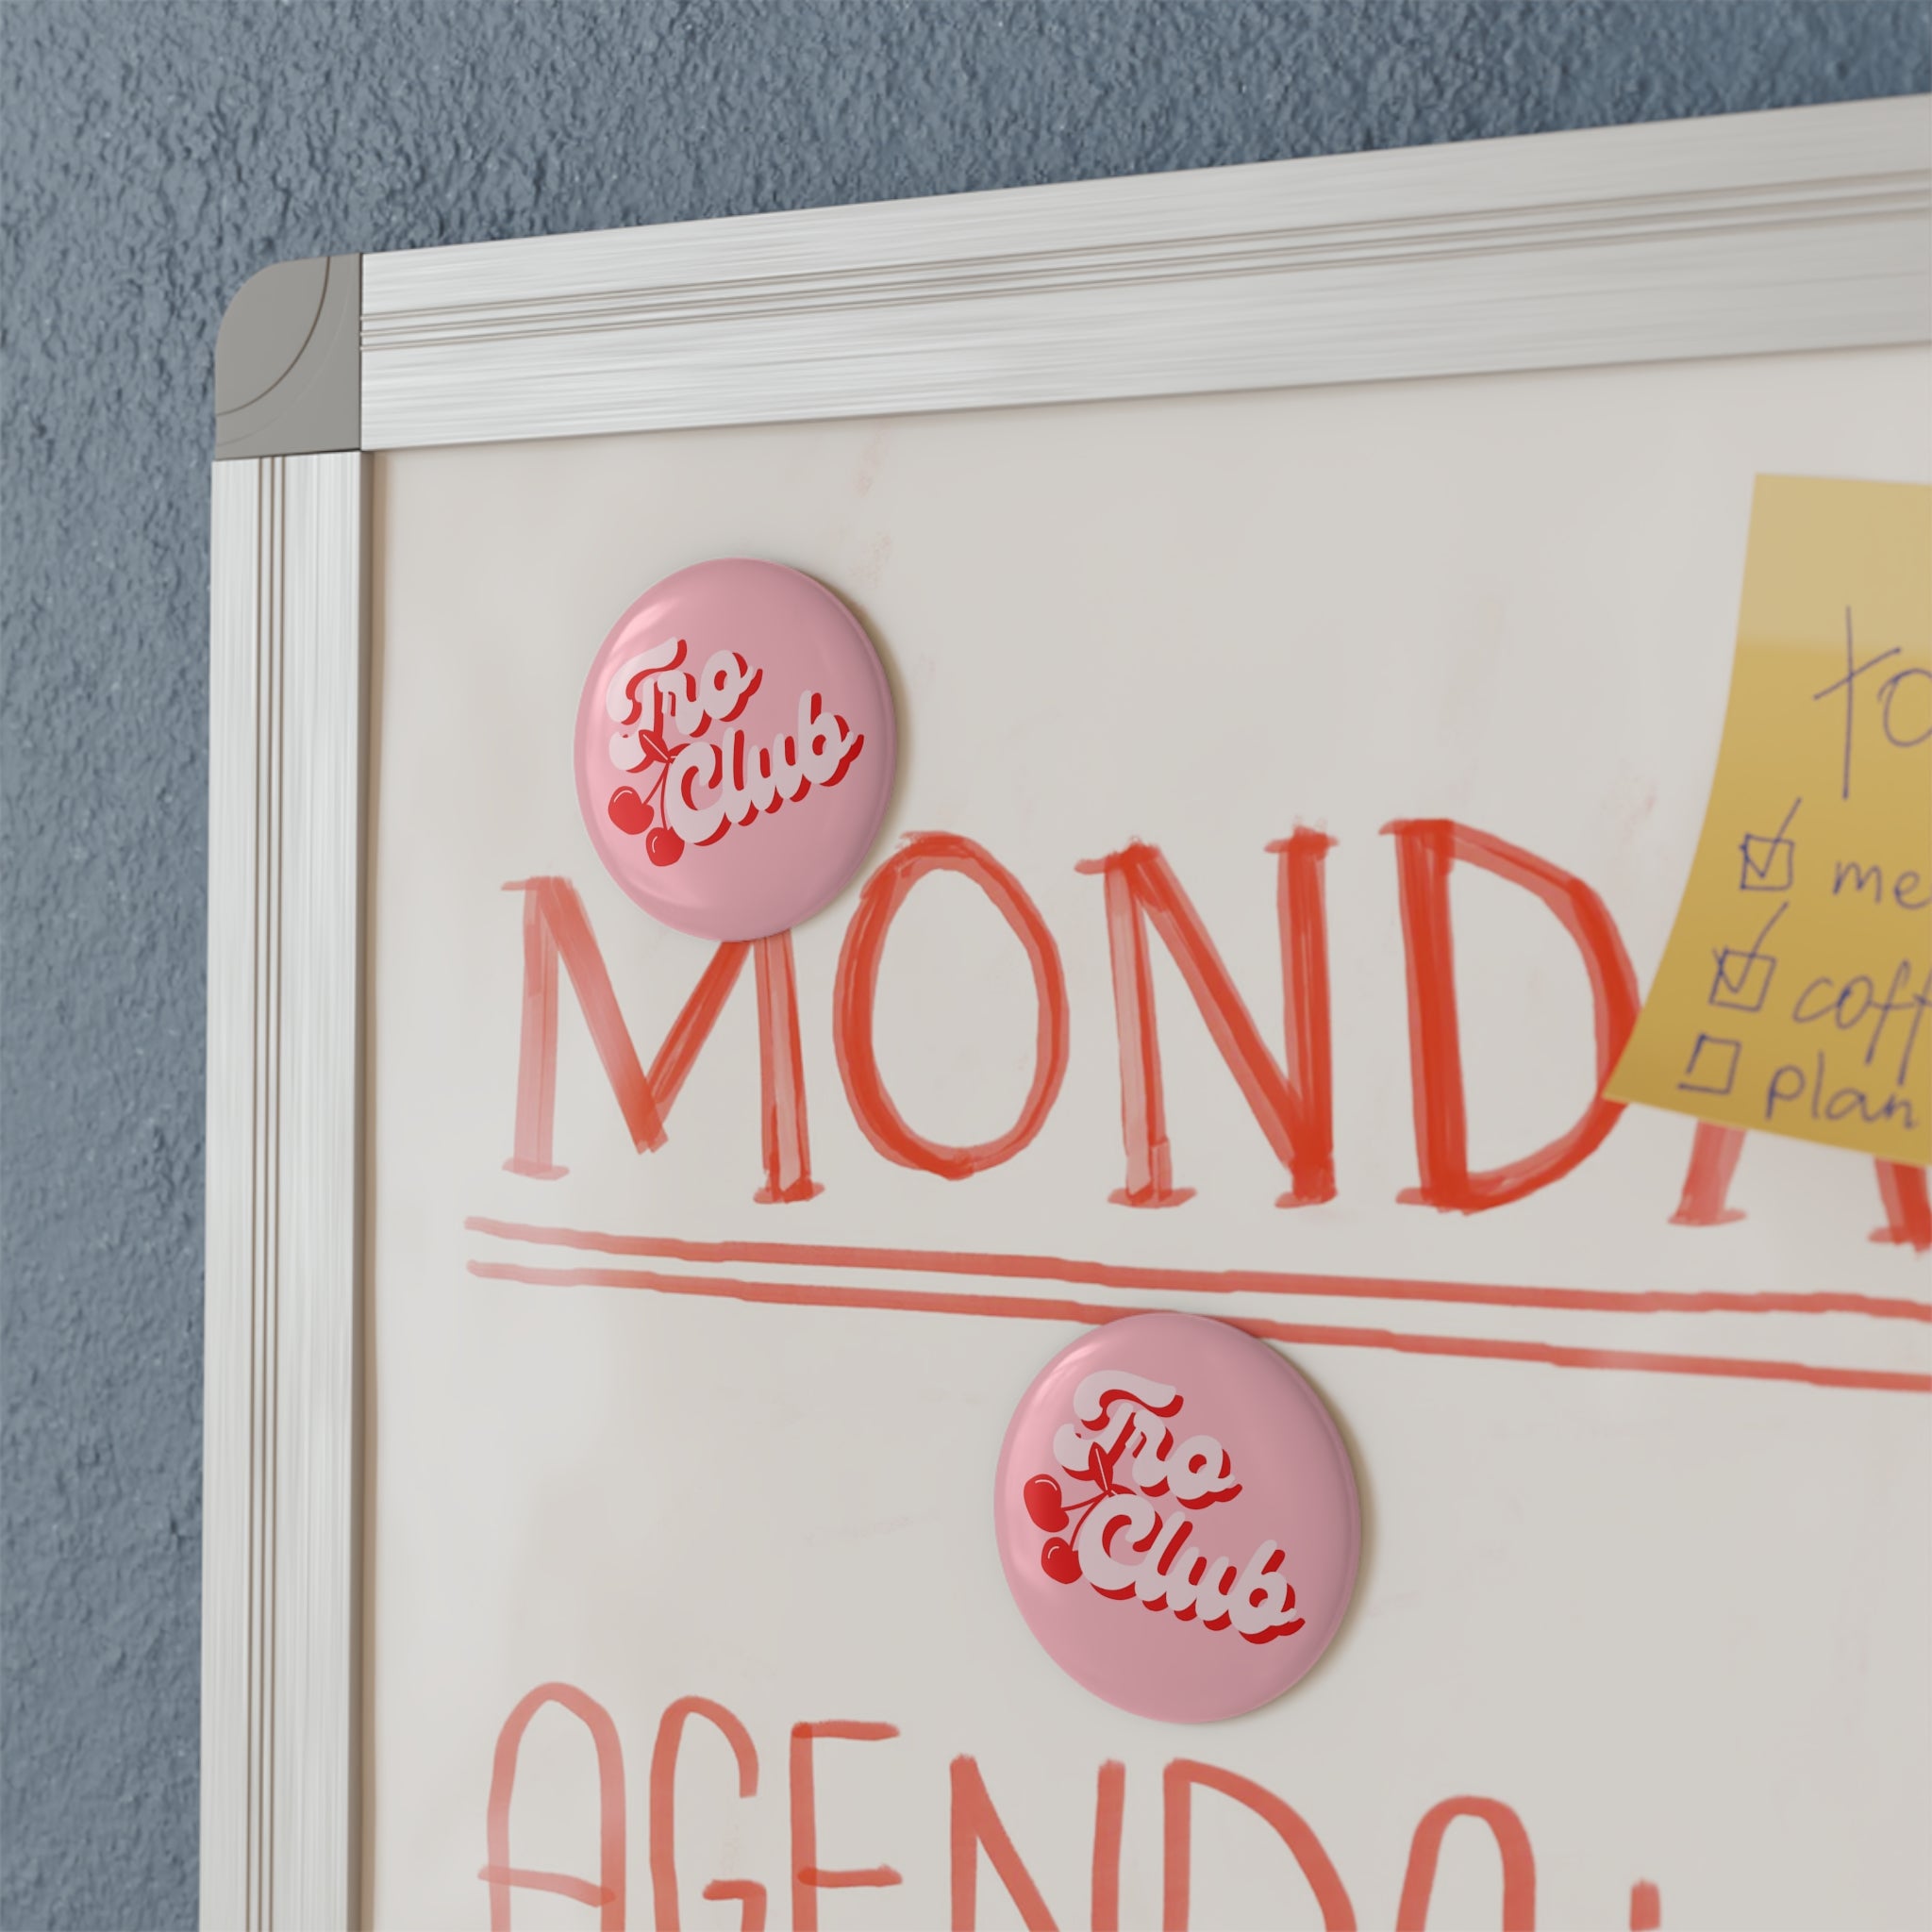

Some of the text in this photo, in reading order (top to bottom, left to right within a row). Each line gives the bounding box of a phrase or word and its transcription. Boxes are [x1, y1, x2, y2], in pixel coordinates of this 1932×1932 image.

[665, 690, 865, 847] Club
[1811, 604, 1932, 802] to
[1764, 1049, 1920, 1130] plan
[1078, 1493, 1307, 1645] Club
